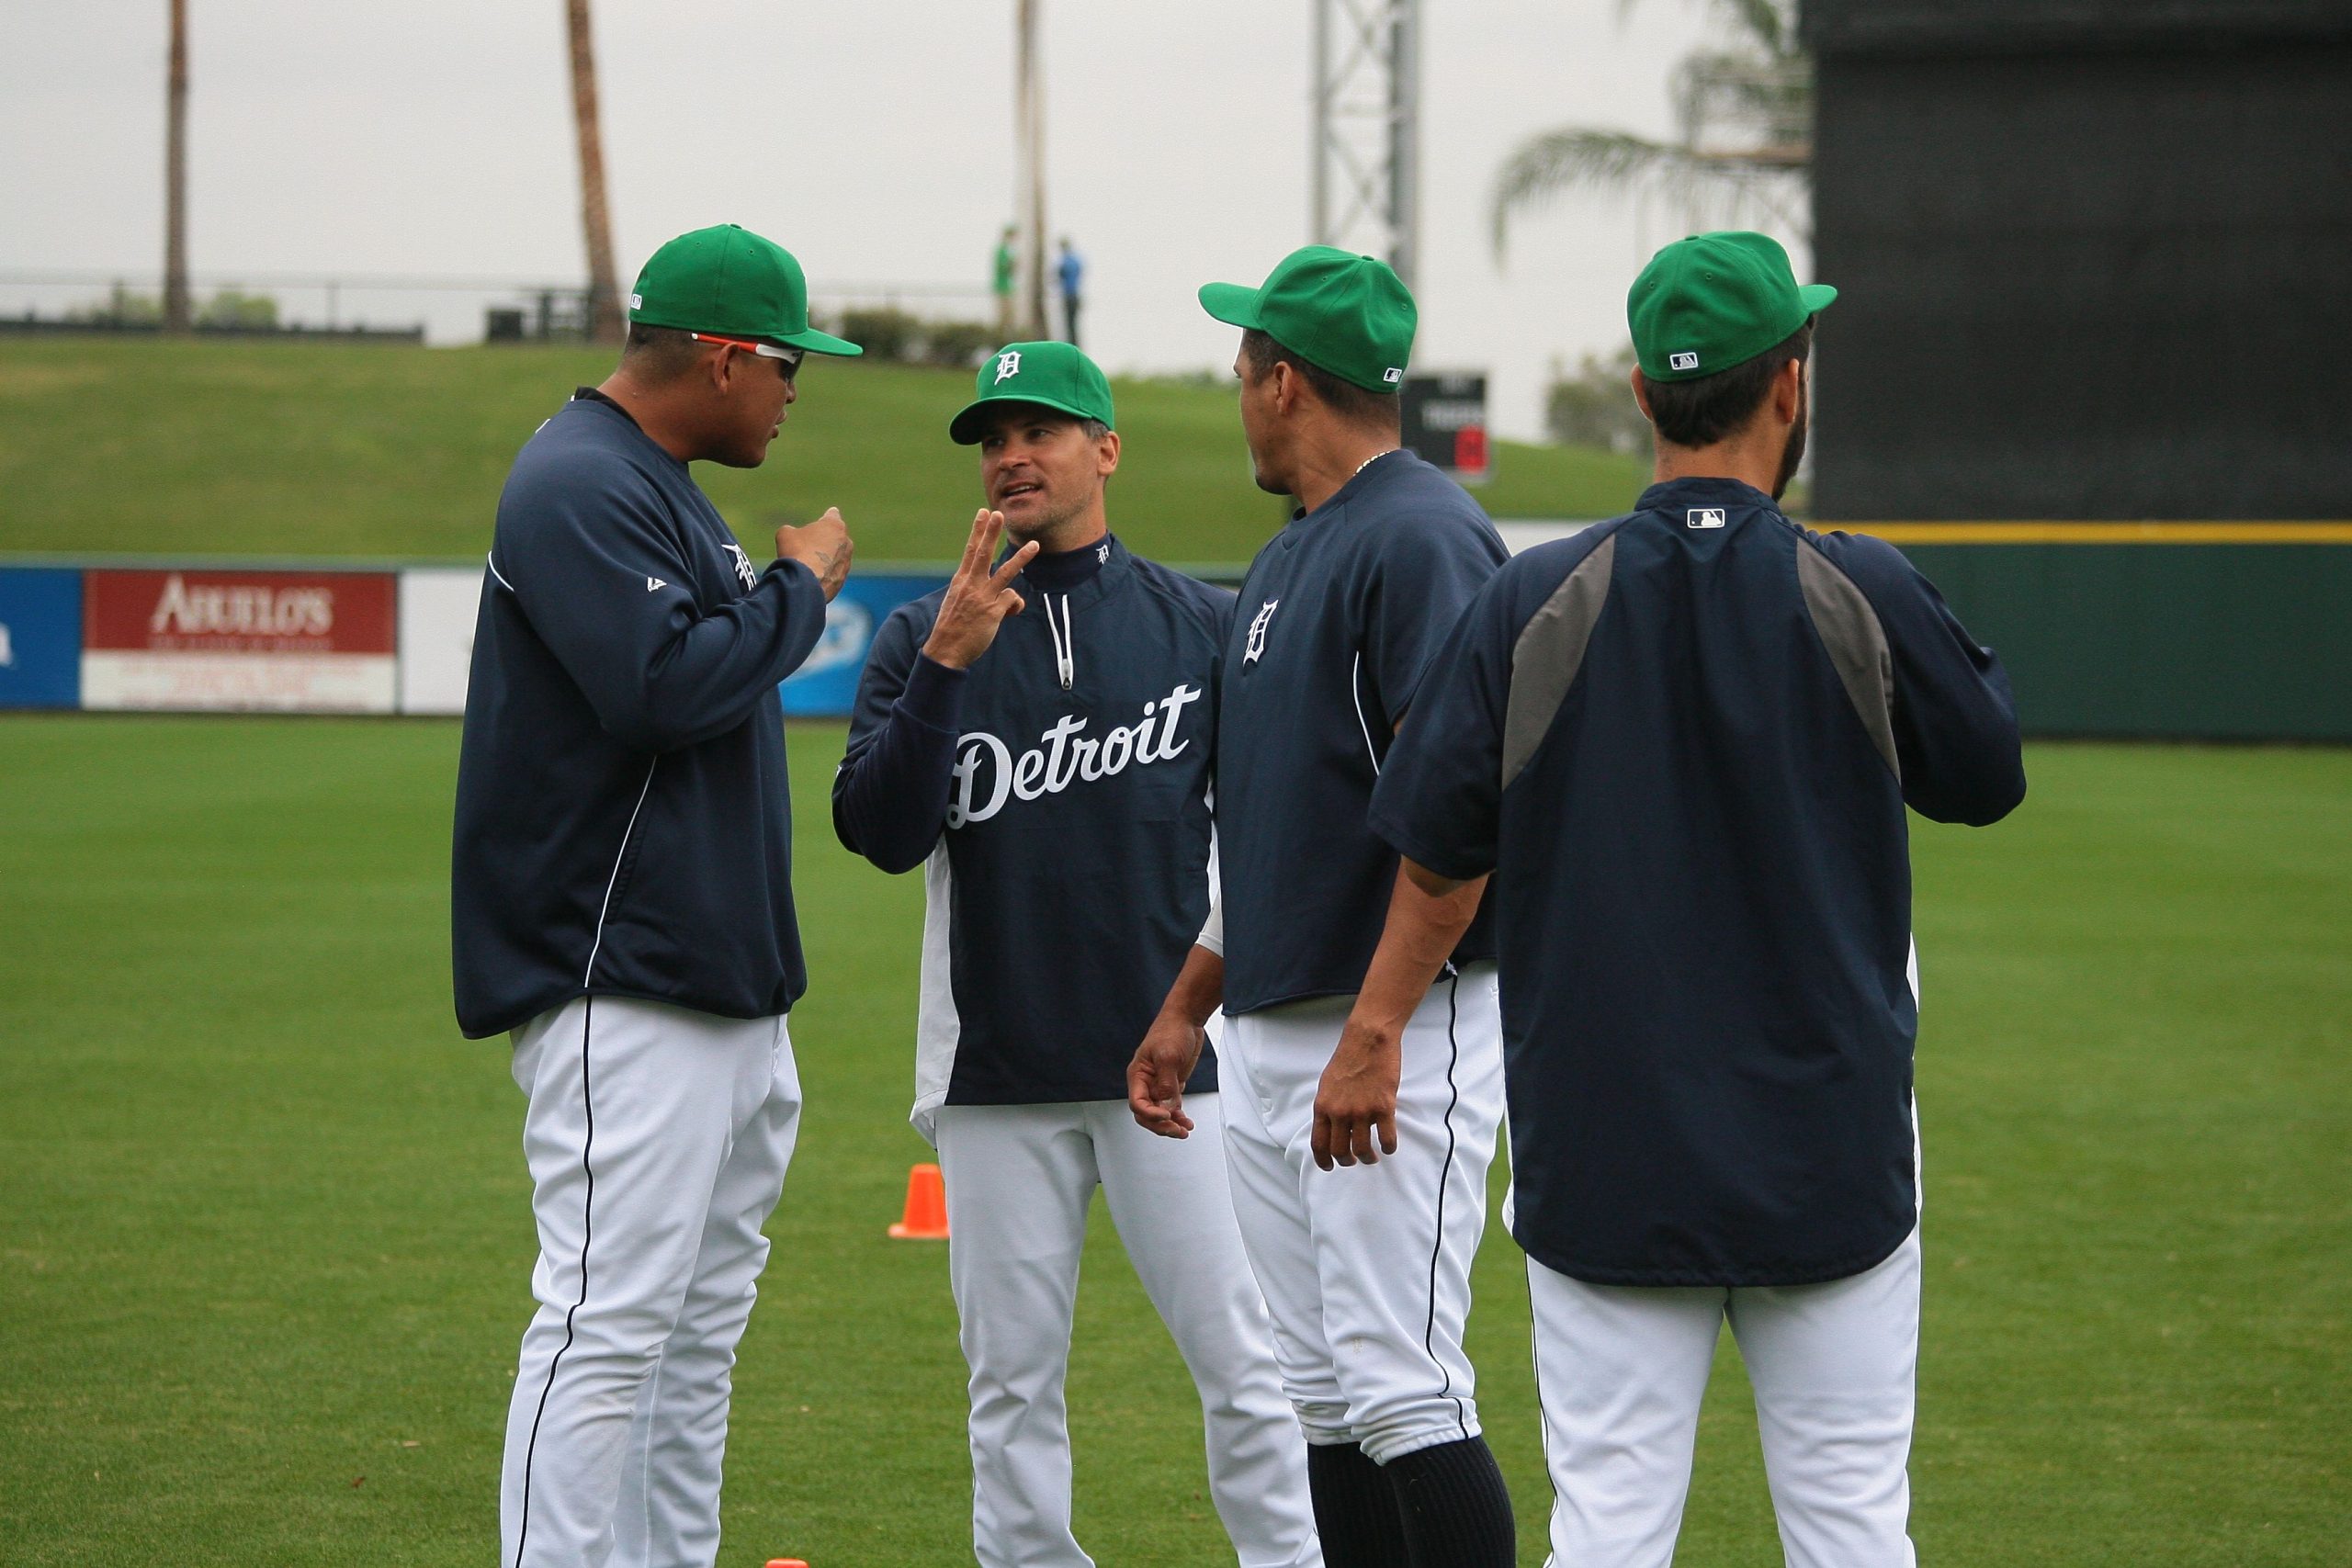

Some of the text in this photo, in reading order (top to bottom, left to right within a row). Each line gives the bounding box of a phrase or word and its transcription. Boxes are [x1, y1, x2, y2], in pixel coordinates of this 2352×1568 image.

[994, 351, 1022, 386] D
[1243, 599, 1279, 668] D
[945, 683, 1202, 829] Detroit
